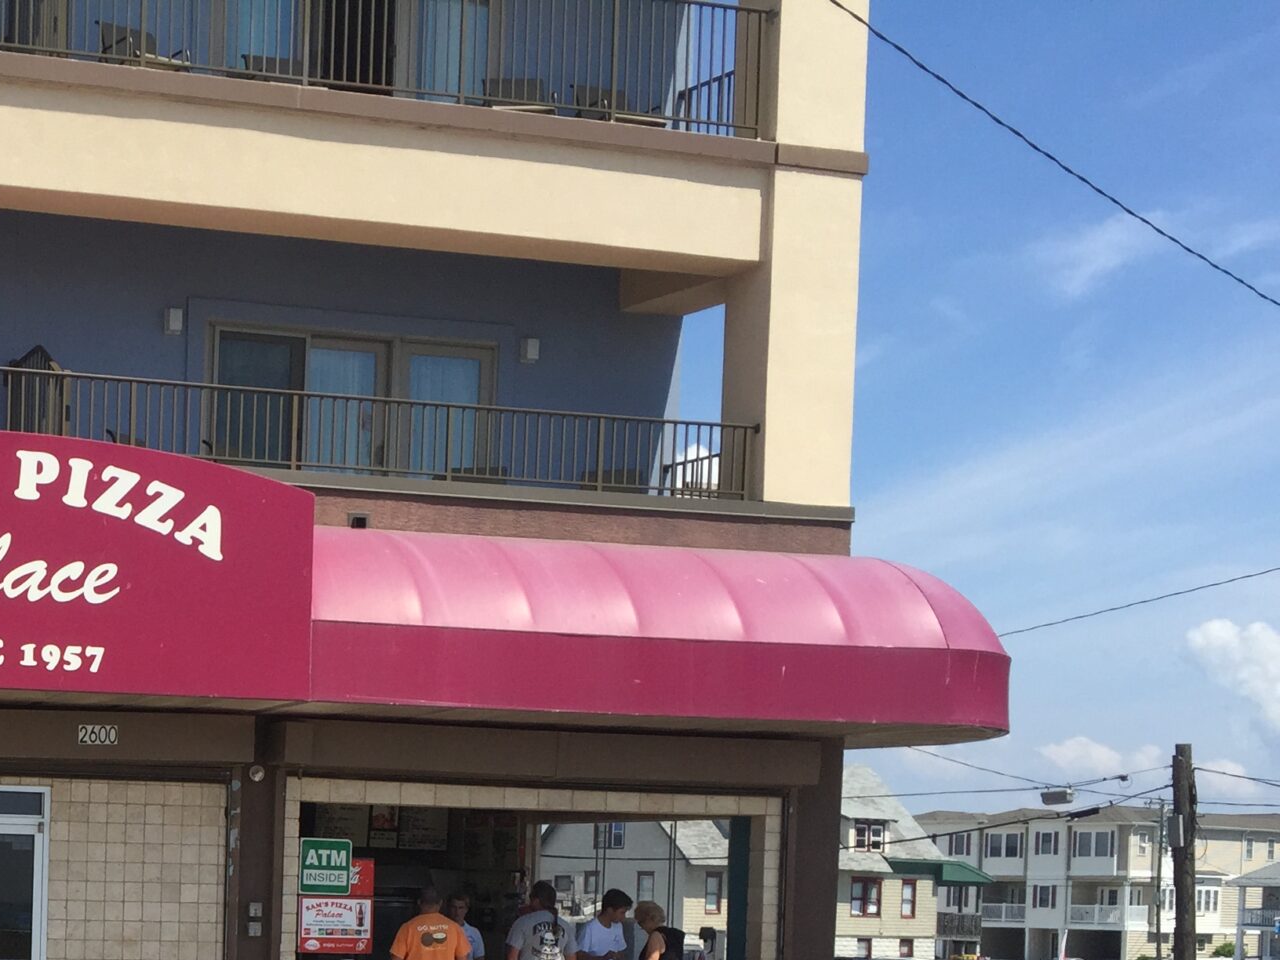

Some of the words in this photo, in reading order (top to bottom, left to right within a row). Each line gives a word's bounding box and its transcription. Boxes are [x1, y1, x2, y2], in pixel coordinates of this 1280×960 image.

[13, 450, 223, 561] PIZZA
[19, 643, 105, 673] 1957
[79, 725, 118, 744] 2600
[304, 849, 347, 867] ATM
[305, 872, 345, 883] INSIDE
[305, 901, 329, 912] SAM'S
[330, 901, 353, 912] PIZZA
